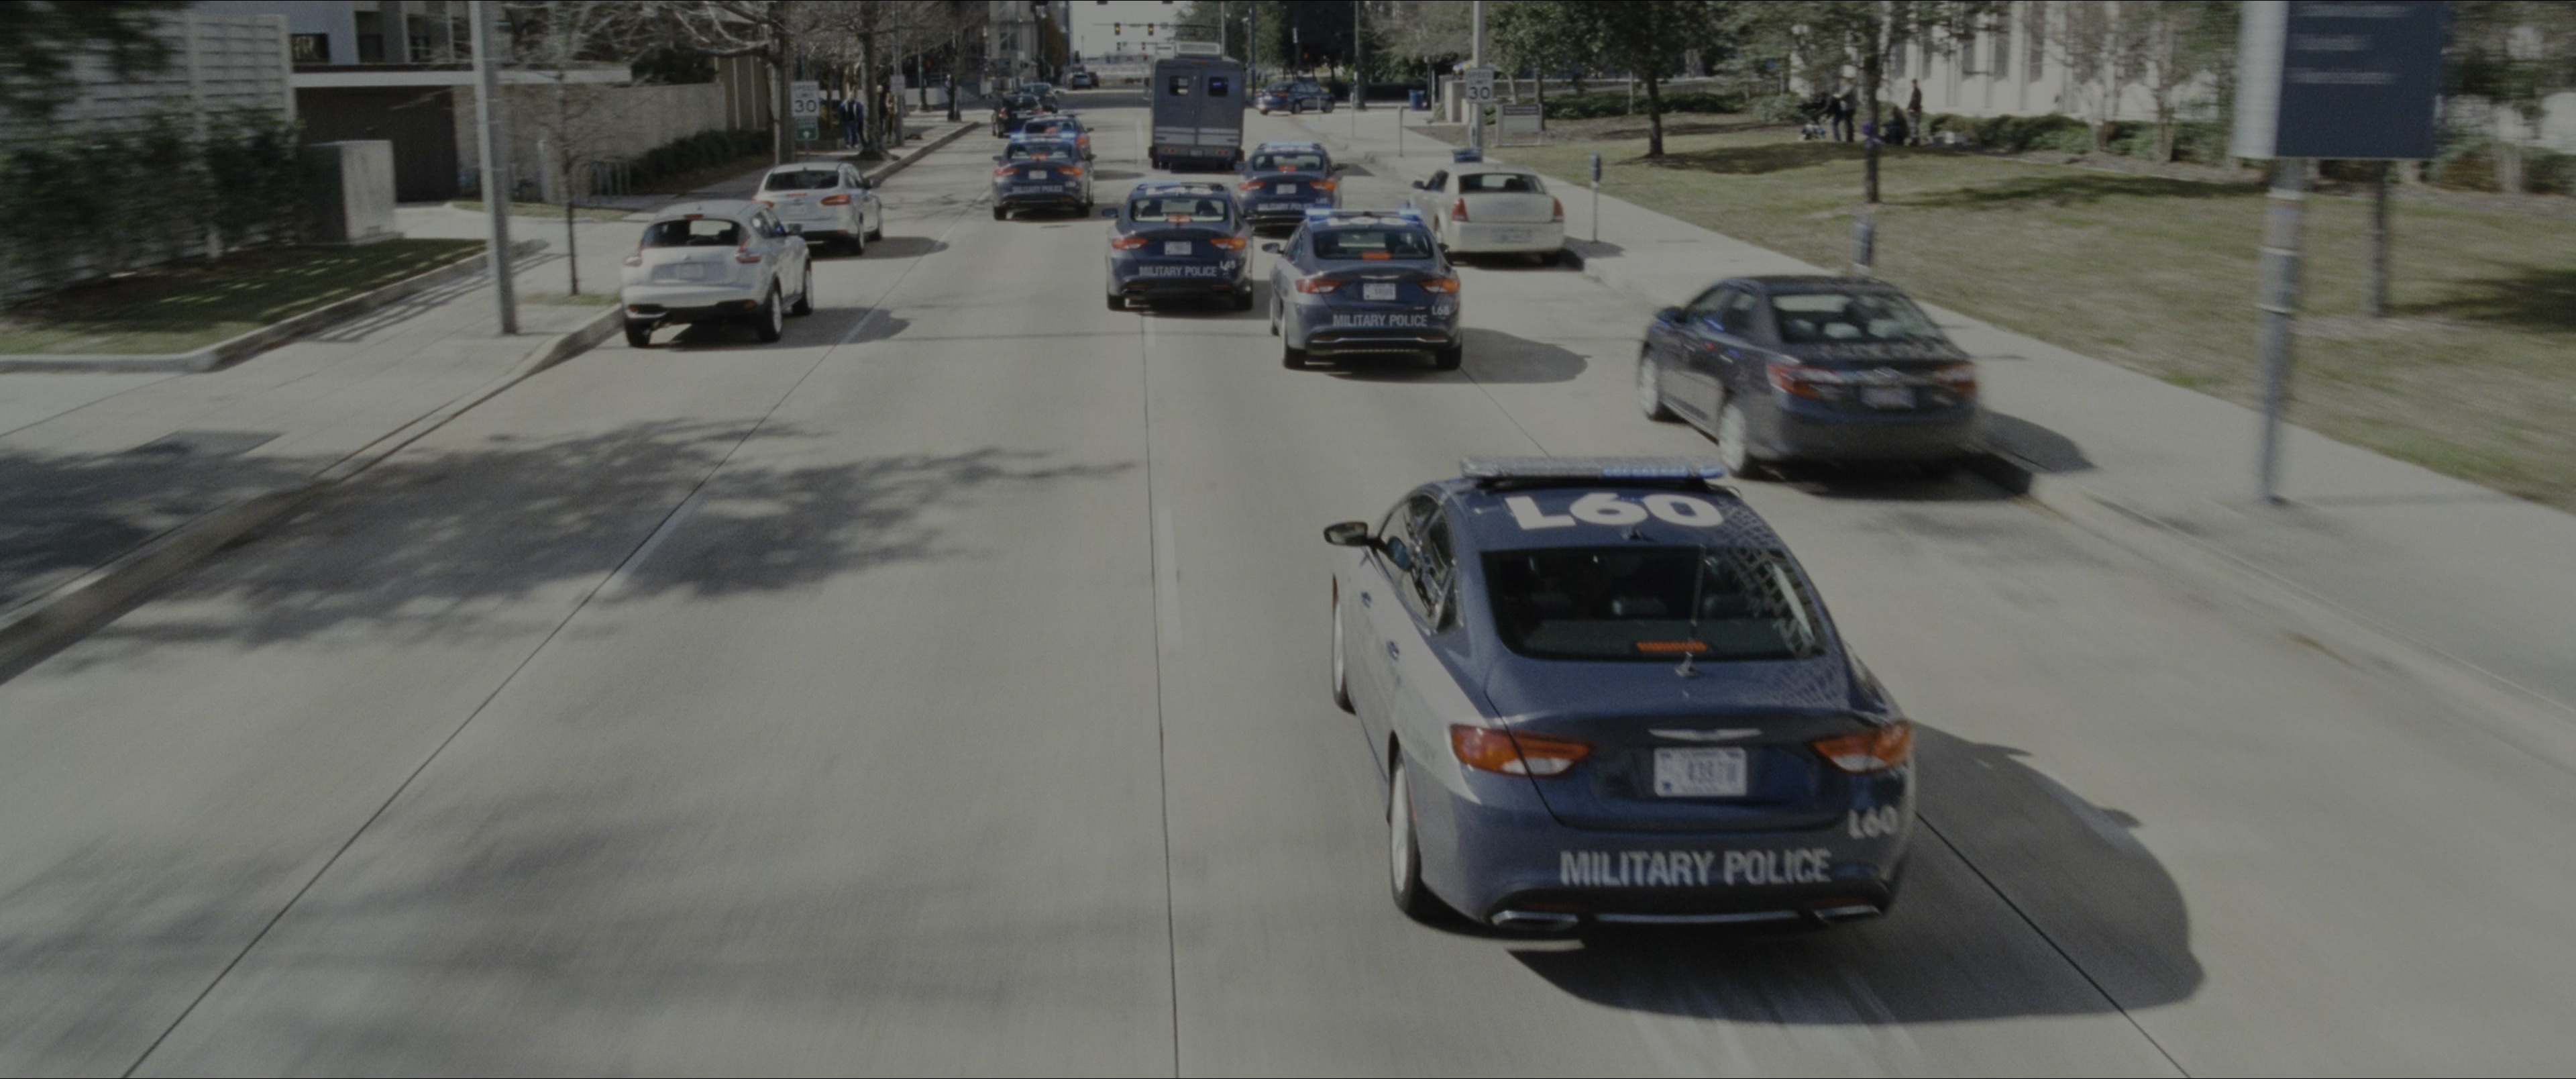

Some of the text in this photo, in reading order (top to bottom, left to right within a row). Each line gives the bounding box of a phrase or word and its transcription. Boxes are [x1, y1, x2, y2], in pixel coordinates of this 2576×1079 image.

[1469, 87, 1490, 99] 30
[794, 100, 816, 113] 30
[1139, 266, 1217, 276] MILITARY POLICE
[1332, 314, 1428, 327] MILITARY POLICE
[1504, 493, 1723, 530] L60
[1848, 806, 1898, 839] L60
[1560, 848, 1832, 886] MILITARY POLICE
